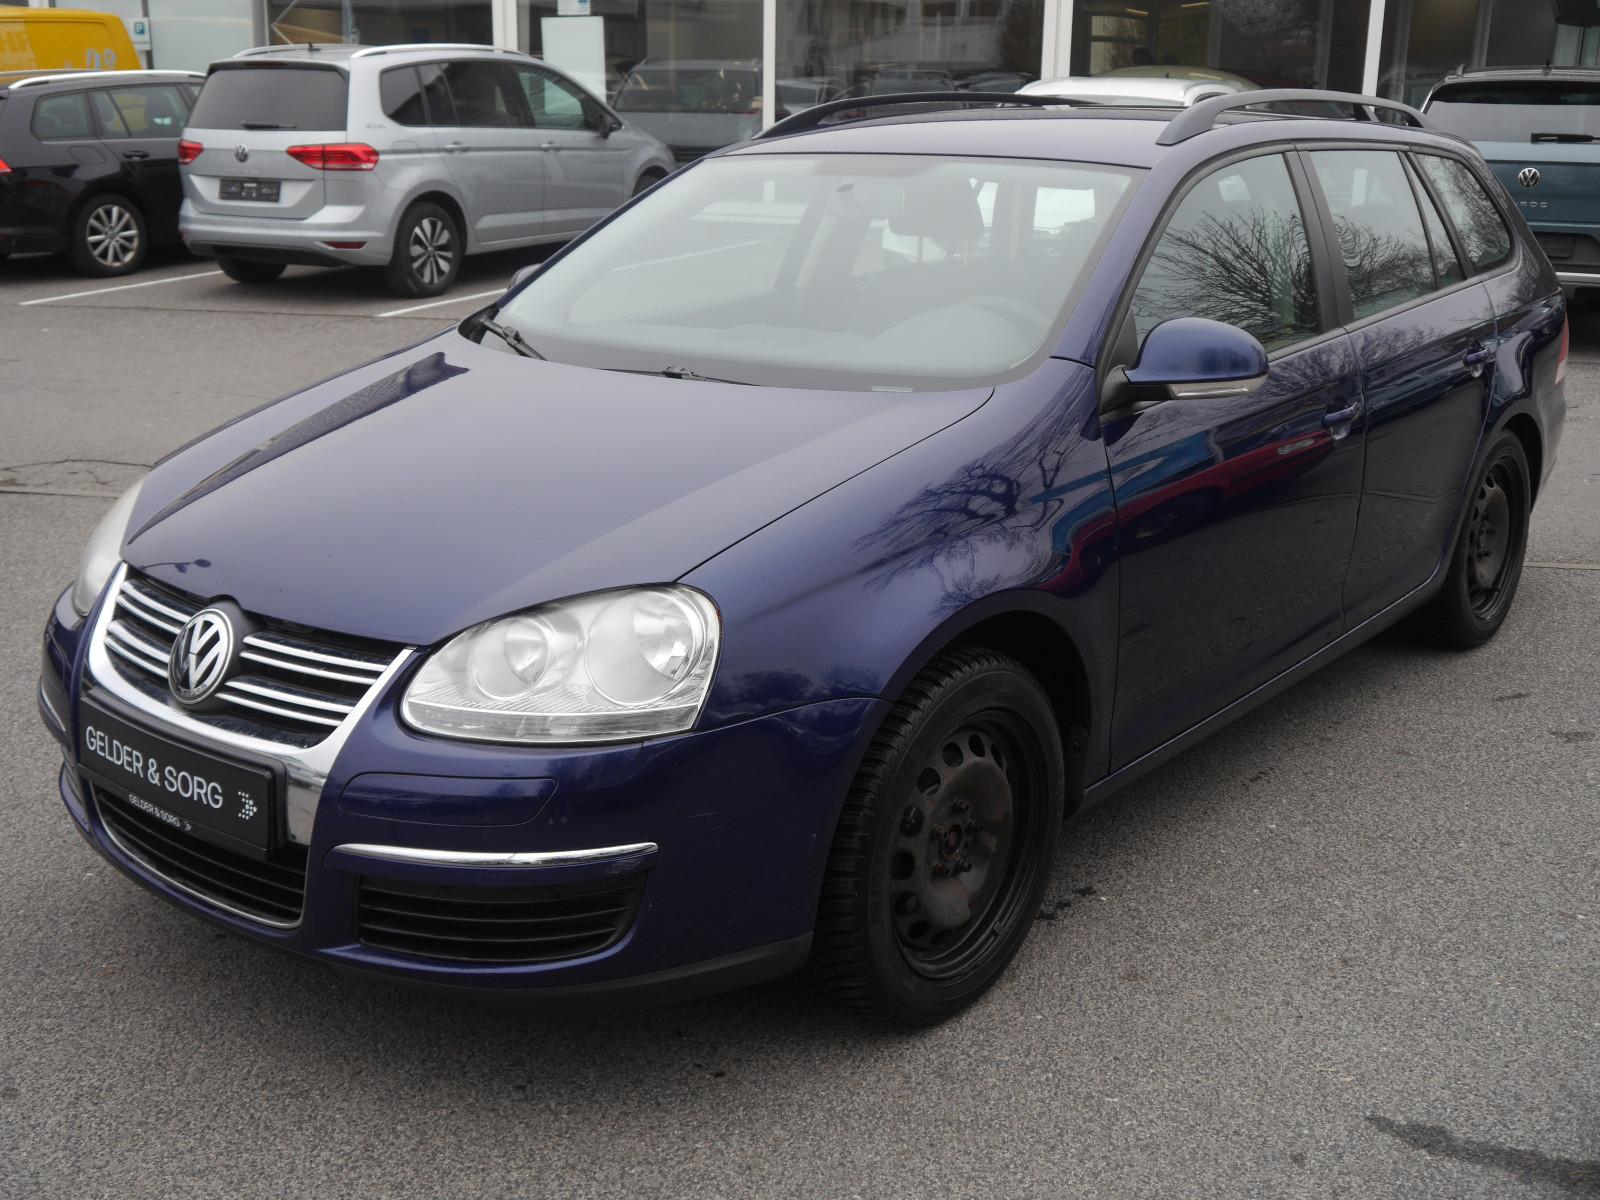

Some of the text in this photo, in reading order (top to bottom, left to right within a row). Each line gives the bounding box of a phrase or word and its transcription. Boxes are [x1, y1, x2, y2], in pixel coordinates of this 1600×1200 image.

[86, 726, 224, 809] GELDER & SORG
[128, 793, 181, 828] GELDER & SORG
